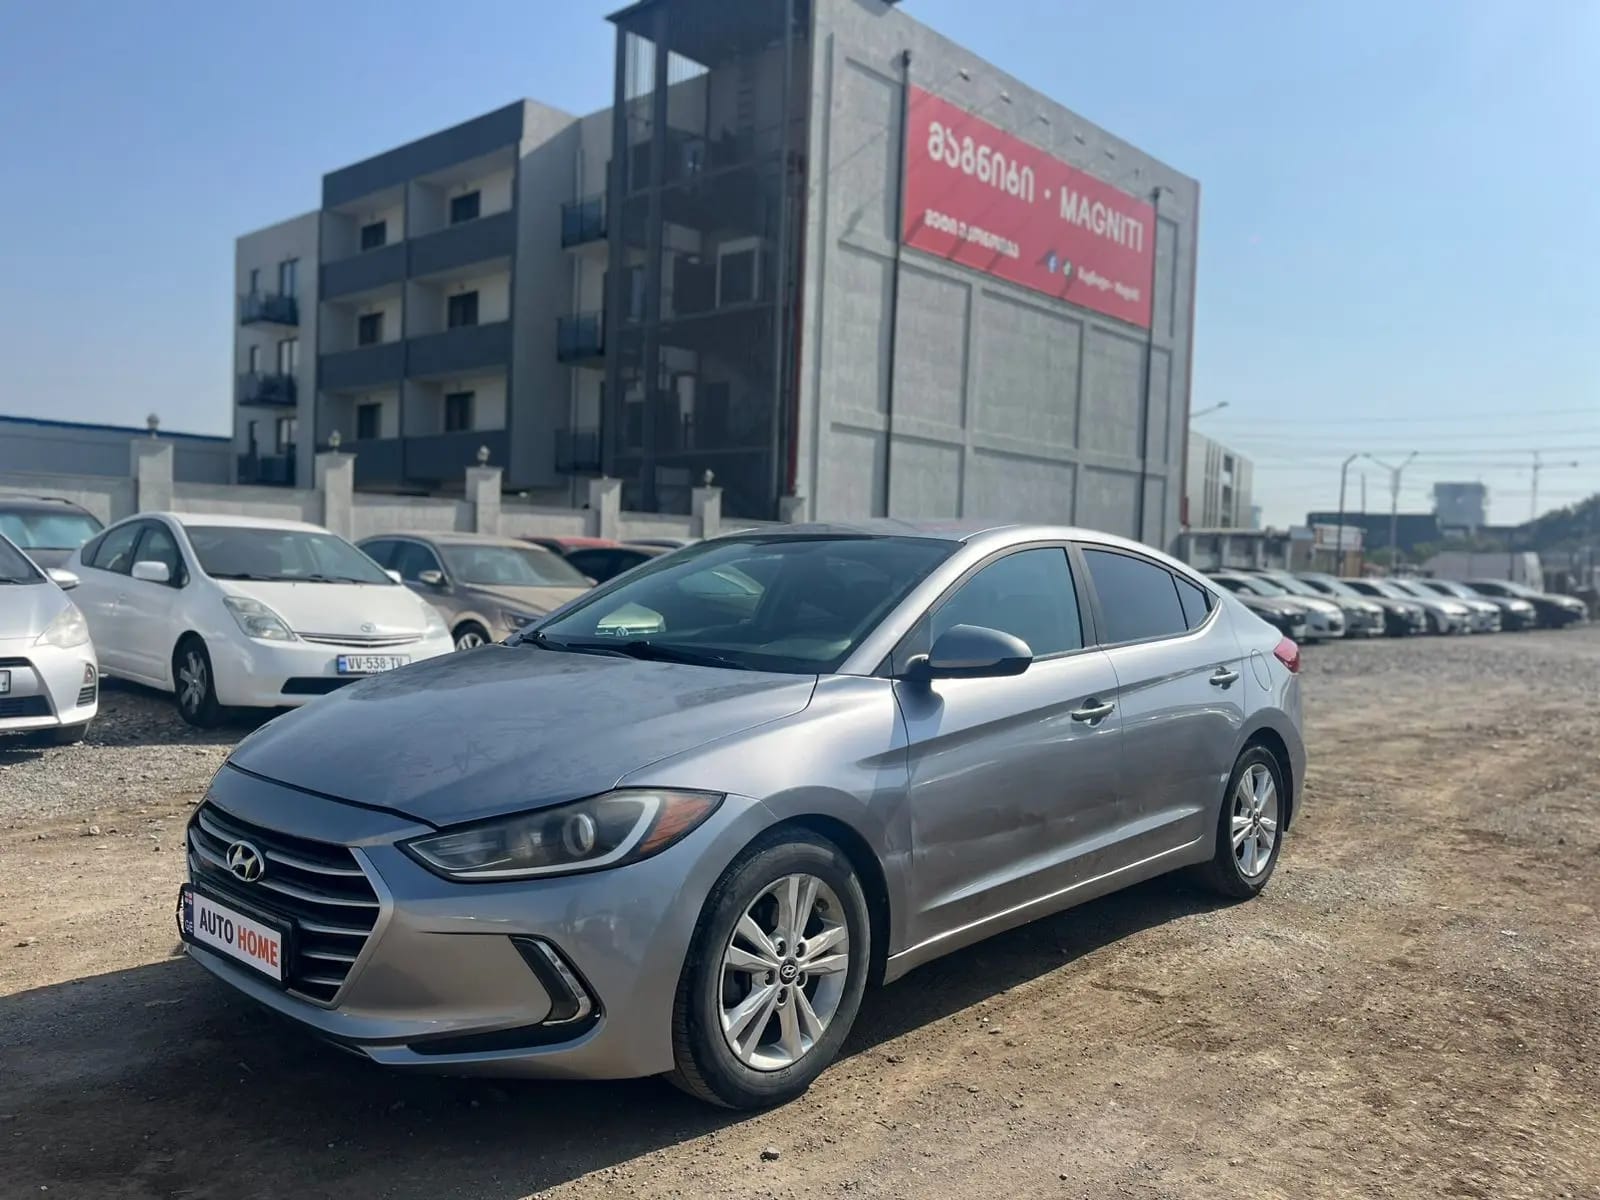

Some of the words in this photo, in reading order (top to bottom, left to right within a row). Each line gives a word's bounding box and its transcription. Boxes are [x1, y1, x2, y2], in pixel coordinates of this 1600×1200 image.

[1059, 185, 1144, 253] MAGNITI
[200, 906, 234, 945] AUTO
[237, 924, 279, 968] HOME
